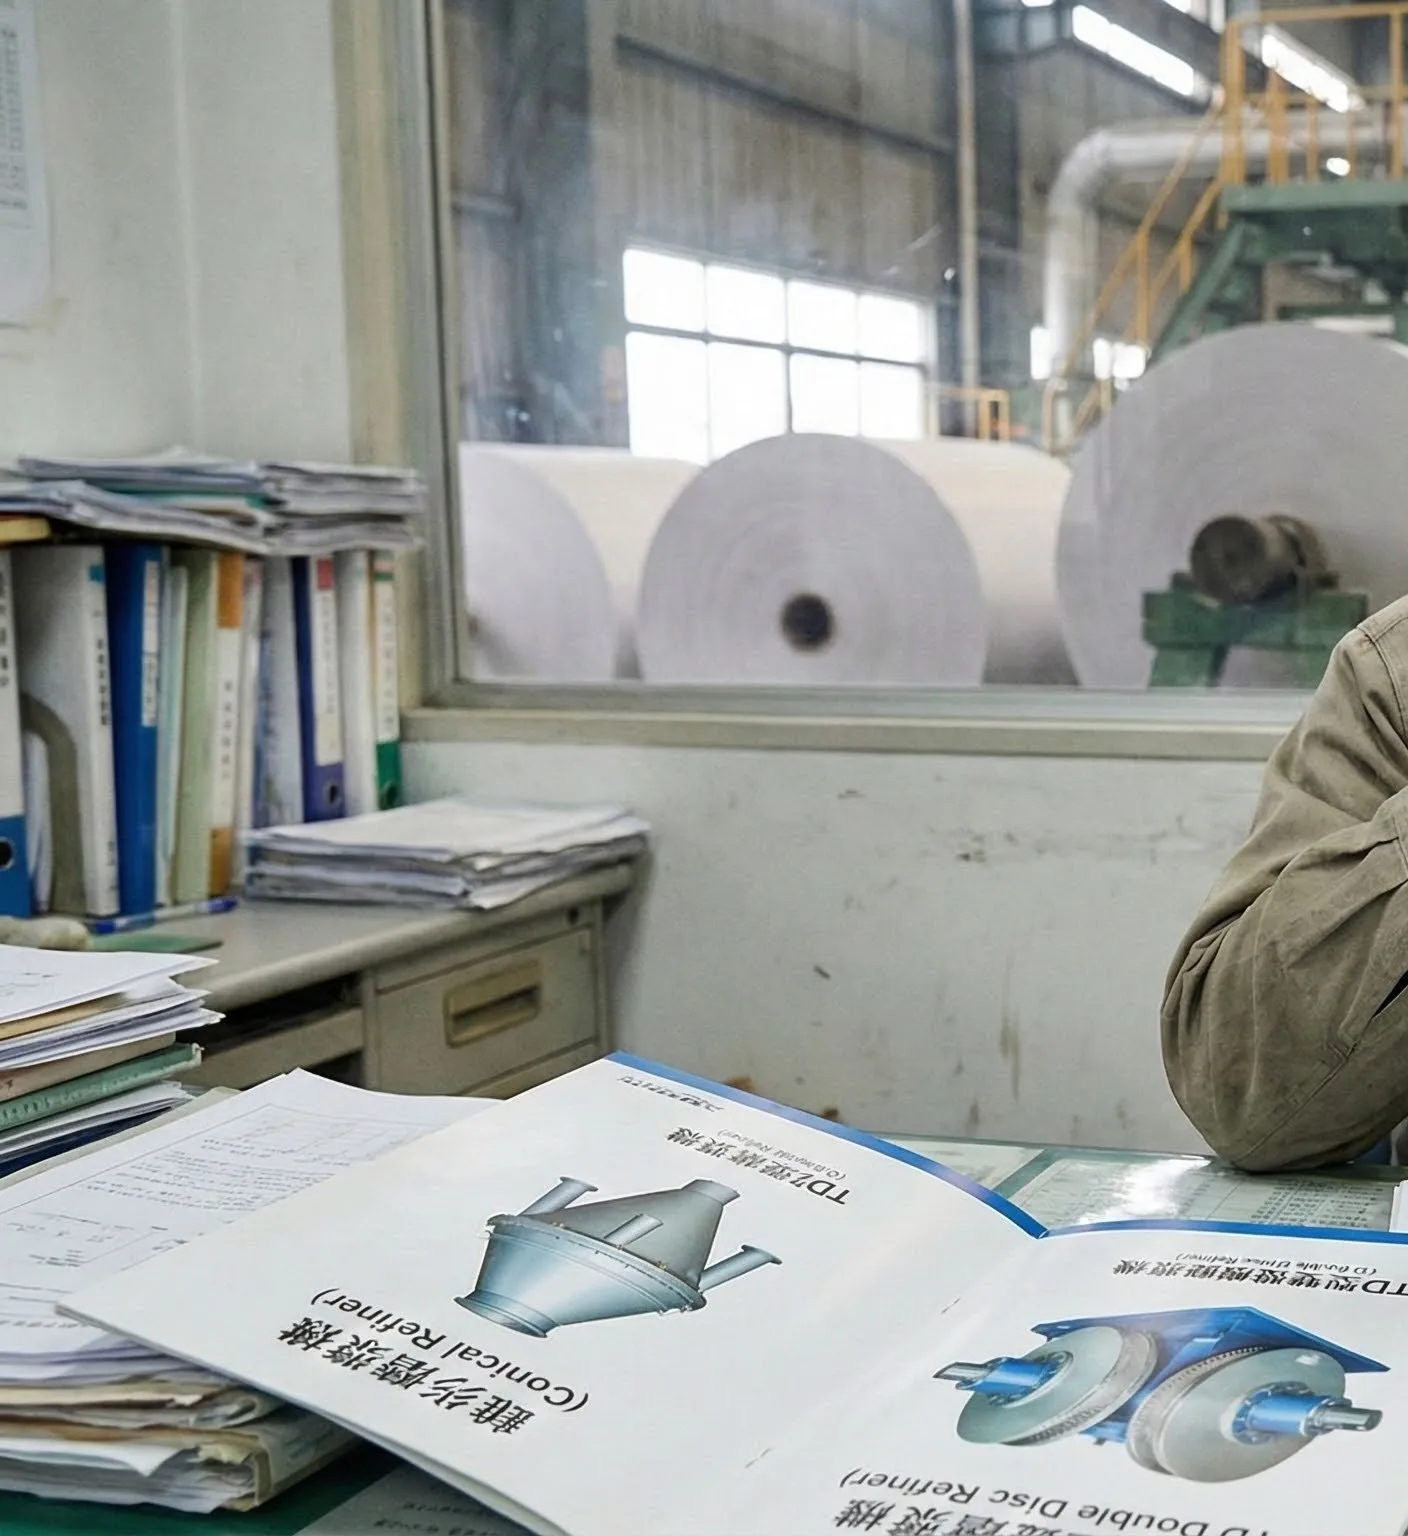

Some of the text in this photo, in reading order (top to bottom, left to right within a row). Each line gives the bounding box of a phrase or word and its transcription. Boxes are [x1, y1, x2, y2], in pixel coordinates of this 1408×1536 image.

[310, 1287, 590, 1414] (Conical Refiner)
[838, 1466, 981, 1505] Refiner)
[987, 1488, 1068, 1520] Disc
[1077, 1502, 1210, 1536] Double
